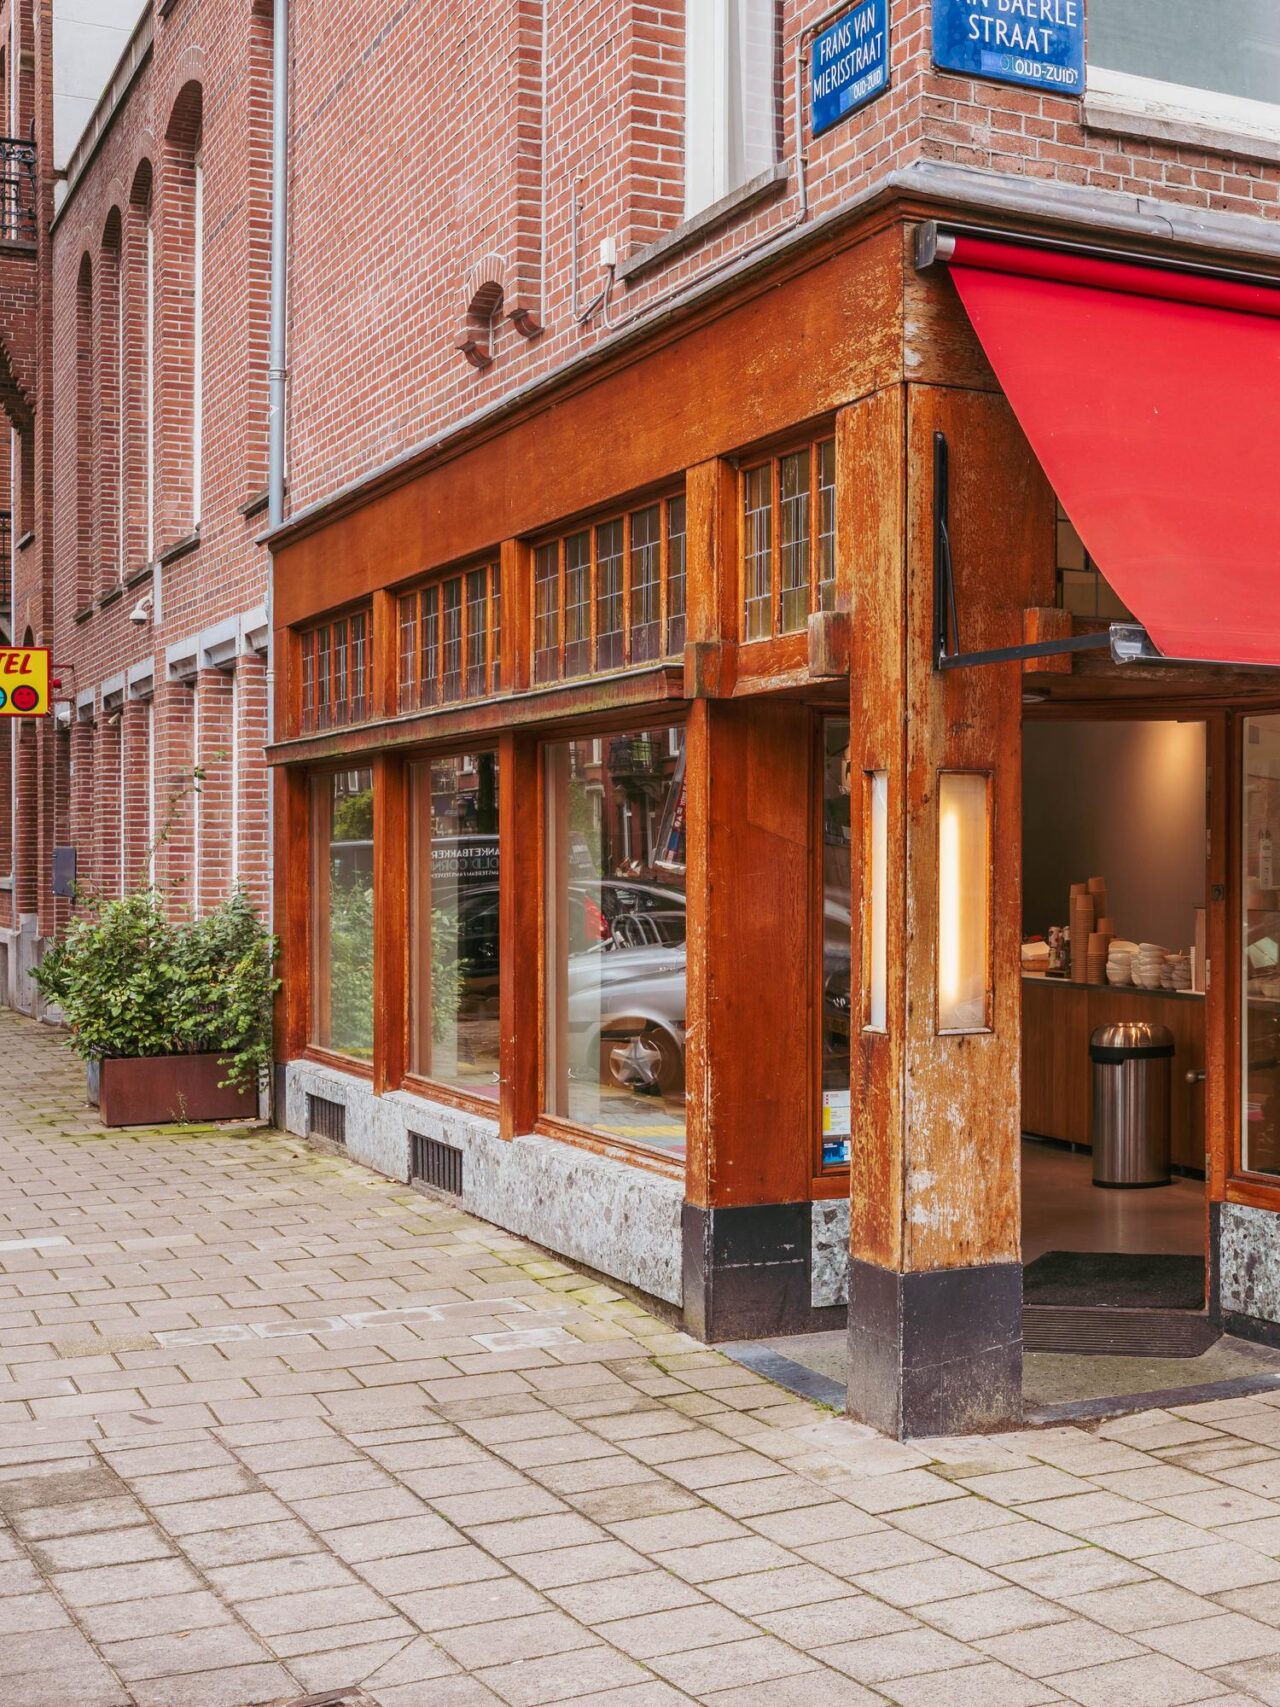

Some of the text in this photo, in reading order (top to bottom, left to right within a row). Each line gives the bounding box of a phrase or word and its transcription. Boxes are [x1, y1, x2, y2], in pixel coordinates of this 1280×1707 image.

[820, 3, 875, 65] FRANS VAN
[968, 14, 1053, 55] STRAAT
[813, 32, 883, 103] MIERISSTRAAT
[853, 69, 881, 99] OUD-ZUID
[1015, 59, 1077, 84] OUD-ZUID
